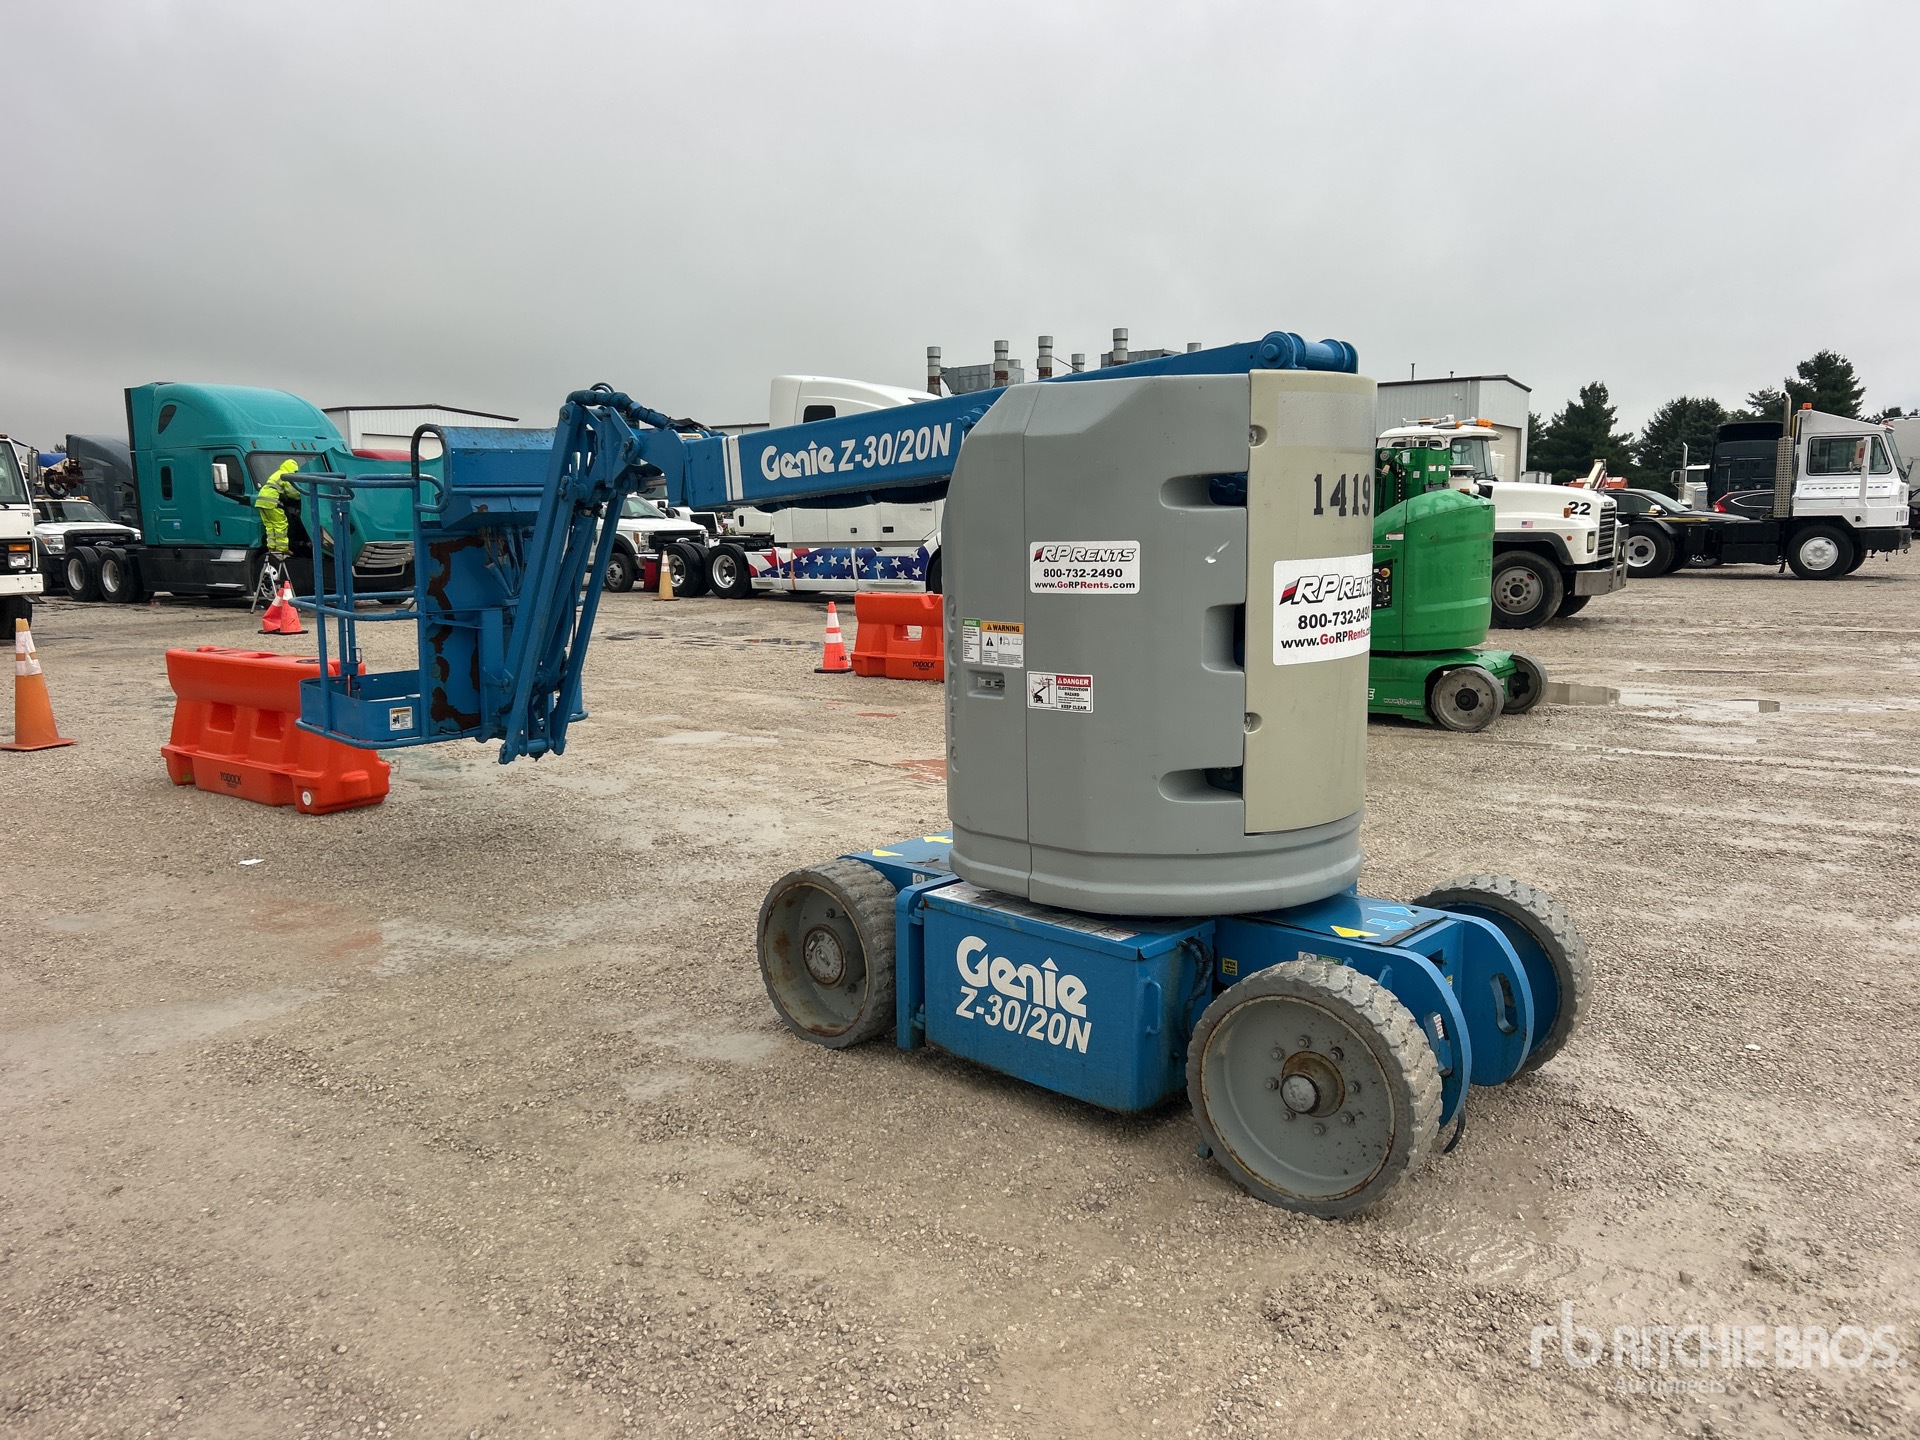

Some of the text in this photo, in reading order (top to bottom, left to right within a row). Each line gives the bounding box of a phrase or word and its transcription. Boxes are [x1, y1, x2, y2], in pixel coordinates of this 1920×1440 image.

[761, 423, 952, 481] Genie Z-30/20N
[1313, 473, 1371, 517] 1419
[1568, 501, 1591, 515] 22
[1043, 568, 1123, 578] 800-732-2490
[1034, 581, 1136, 589] www.GoRPRents.com
[993, 624, 1020, 632] WARNING
[1062, 677, 1089, 685] DANGER
[956, 935, 1088, 1018] Genie
[956, 985, 1092, 1054] Z-30/20N
